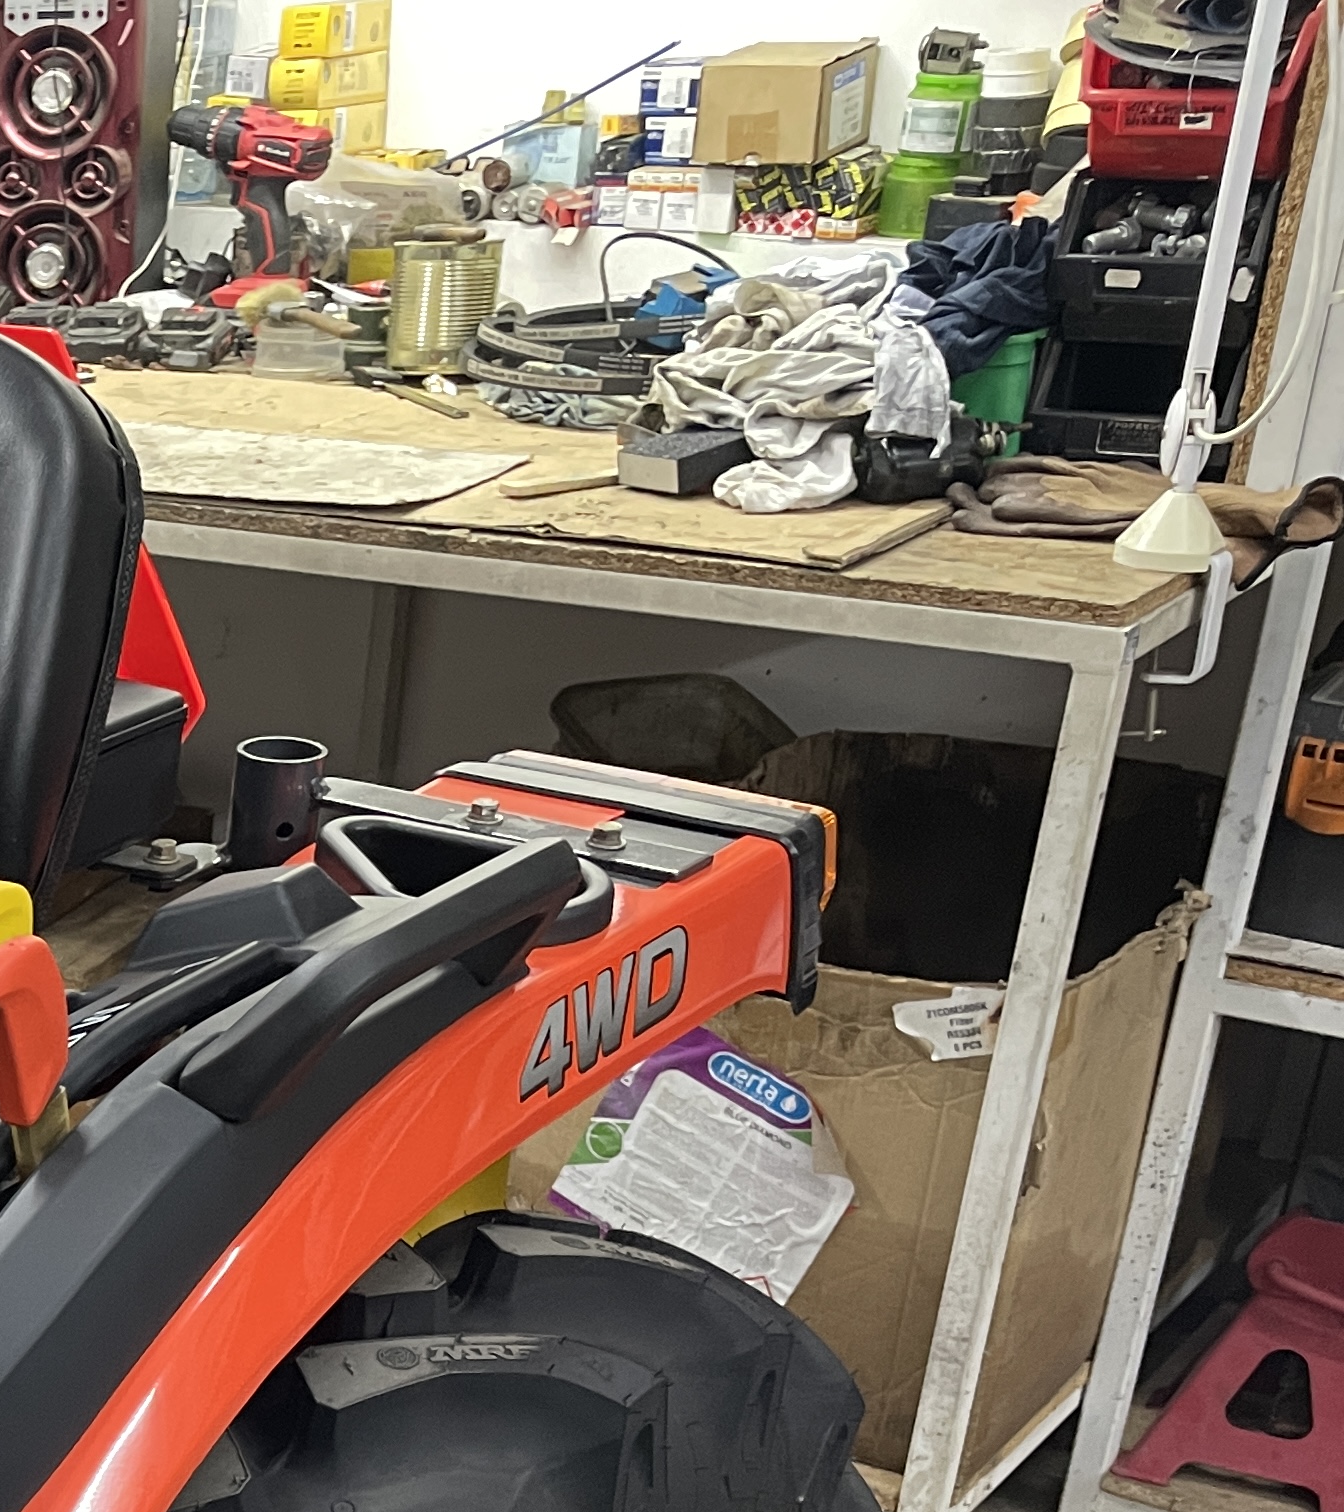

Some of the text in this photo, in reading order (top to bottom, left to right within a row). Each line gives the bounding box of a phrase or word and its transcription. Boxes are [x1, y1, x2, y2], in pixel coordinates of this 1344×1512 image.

[519, 924, 689, 1104] 4WD
[718, 1058, 780, 1103] nerta
[429, 1343, 545, 1363] MRF
